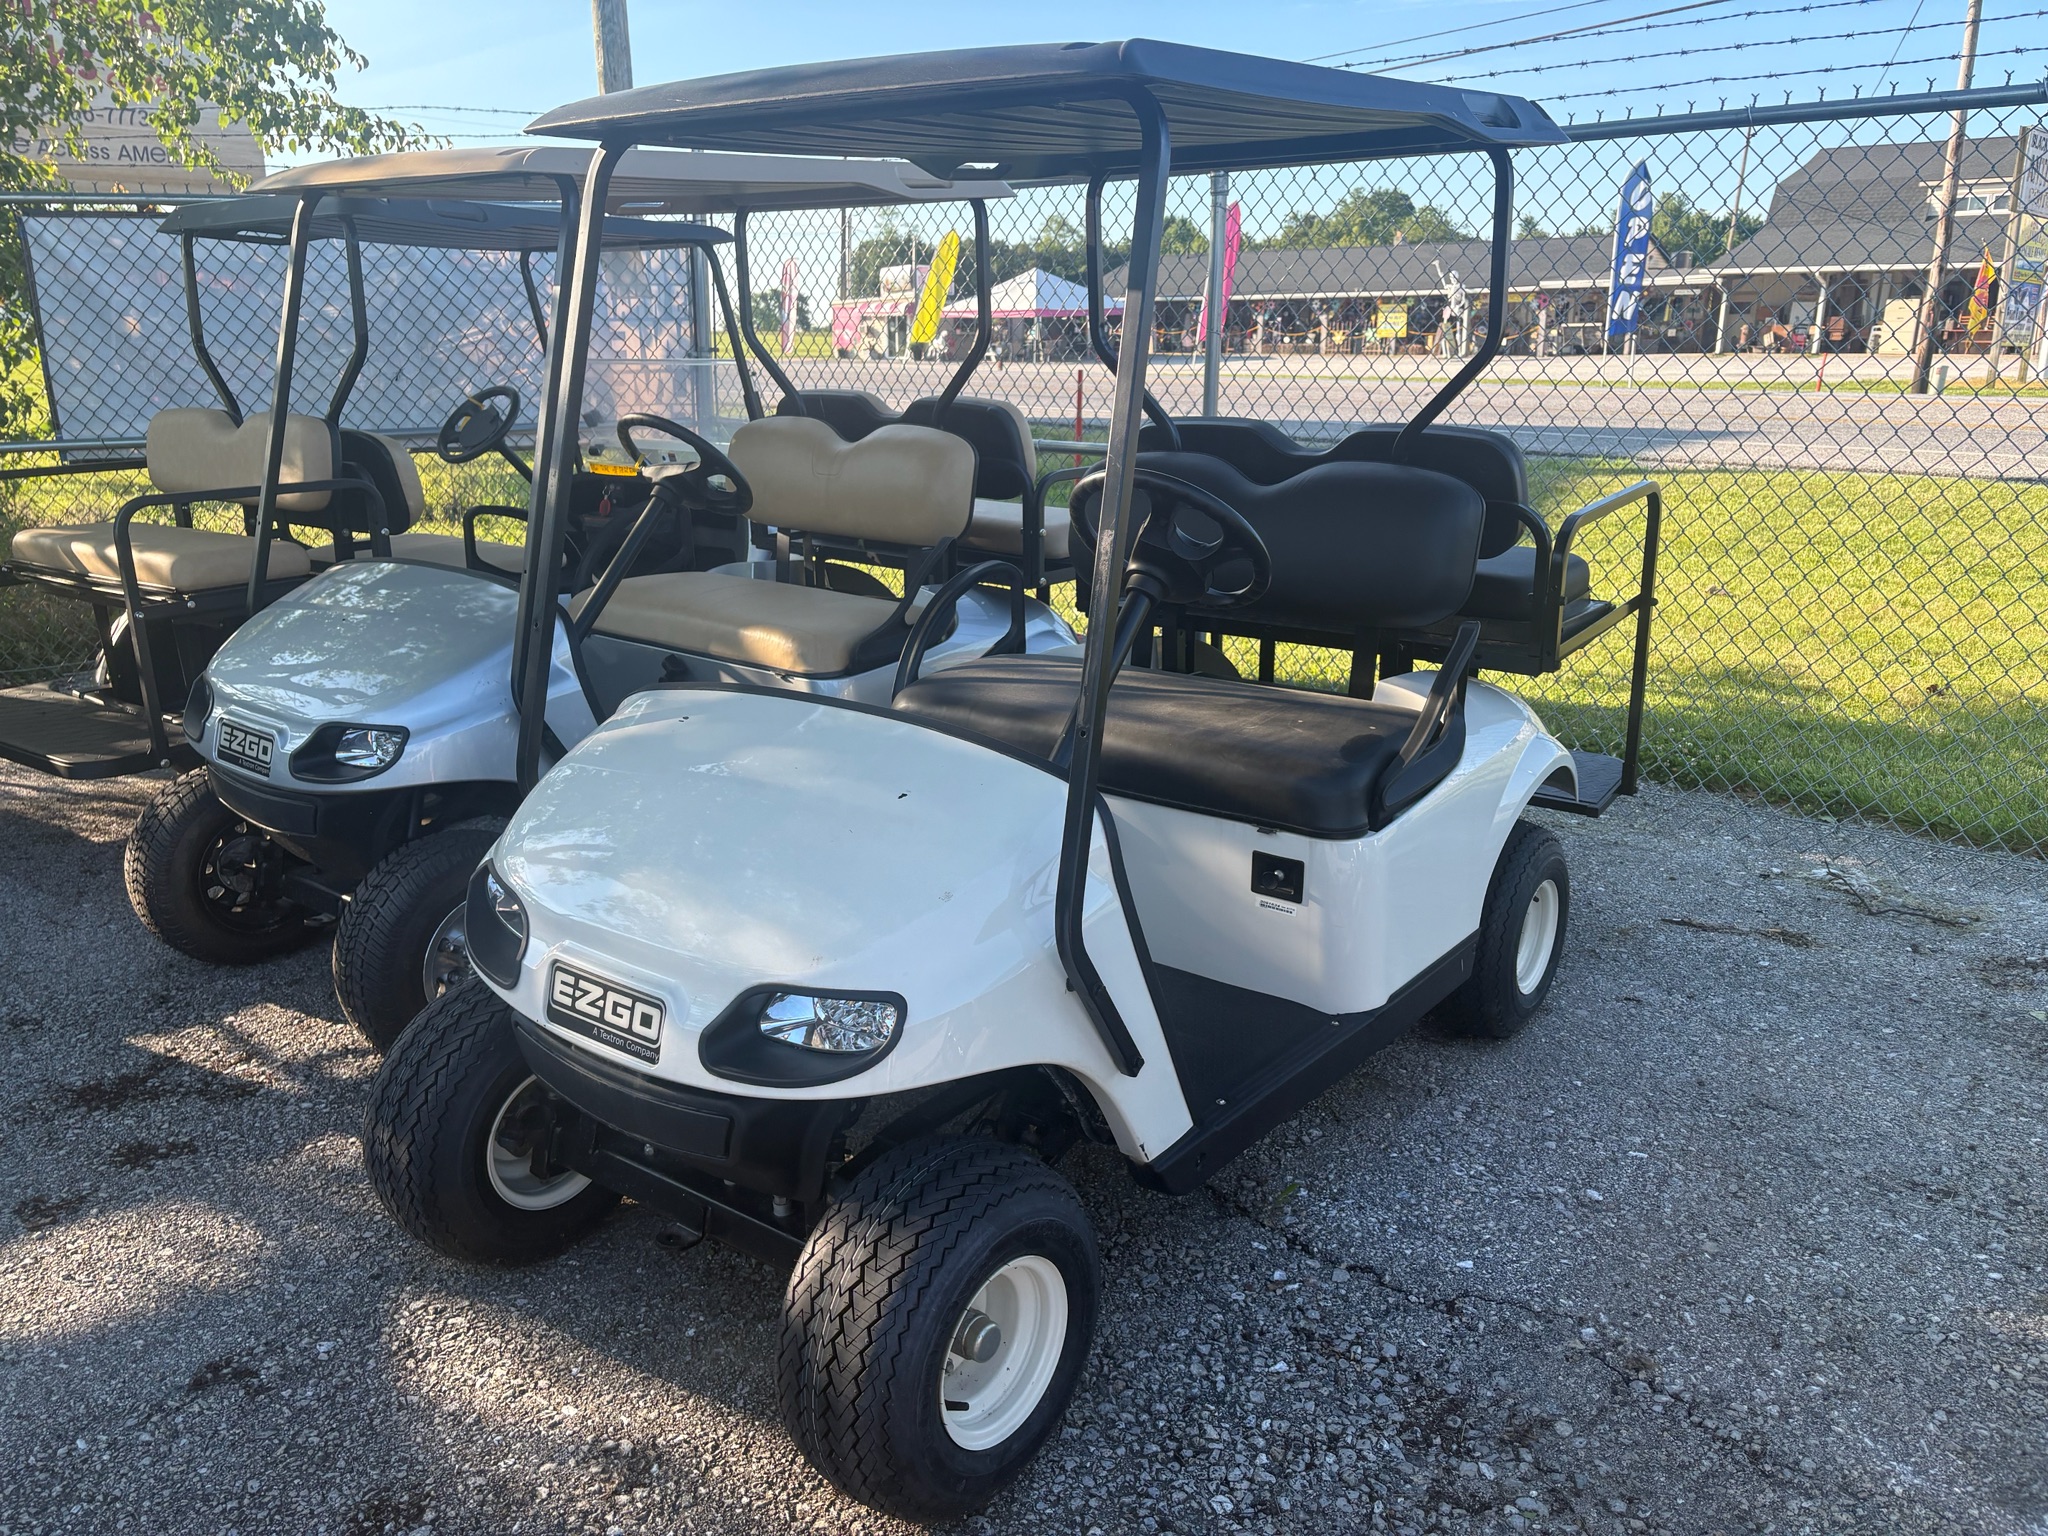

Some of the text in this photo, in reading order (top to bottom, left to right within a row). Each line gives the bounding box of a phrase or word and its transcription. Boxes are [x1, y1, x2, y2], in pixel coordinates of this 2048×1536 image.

[37, 138, 110, 160] Acss
[1612, 180, 1652, 321] OPEN
[220, 725, 273, 763] EZGO
[553, 970, 661, 1041] EZGO
[592, 1026, 660, 1063] A Textron Company
